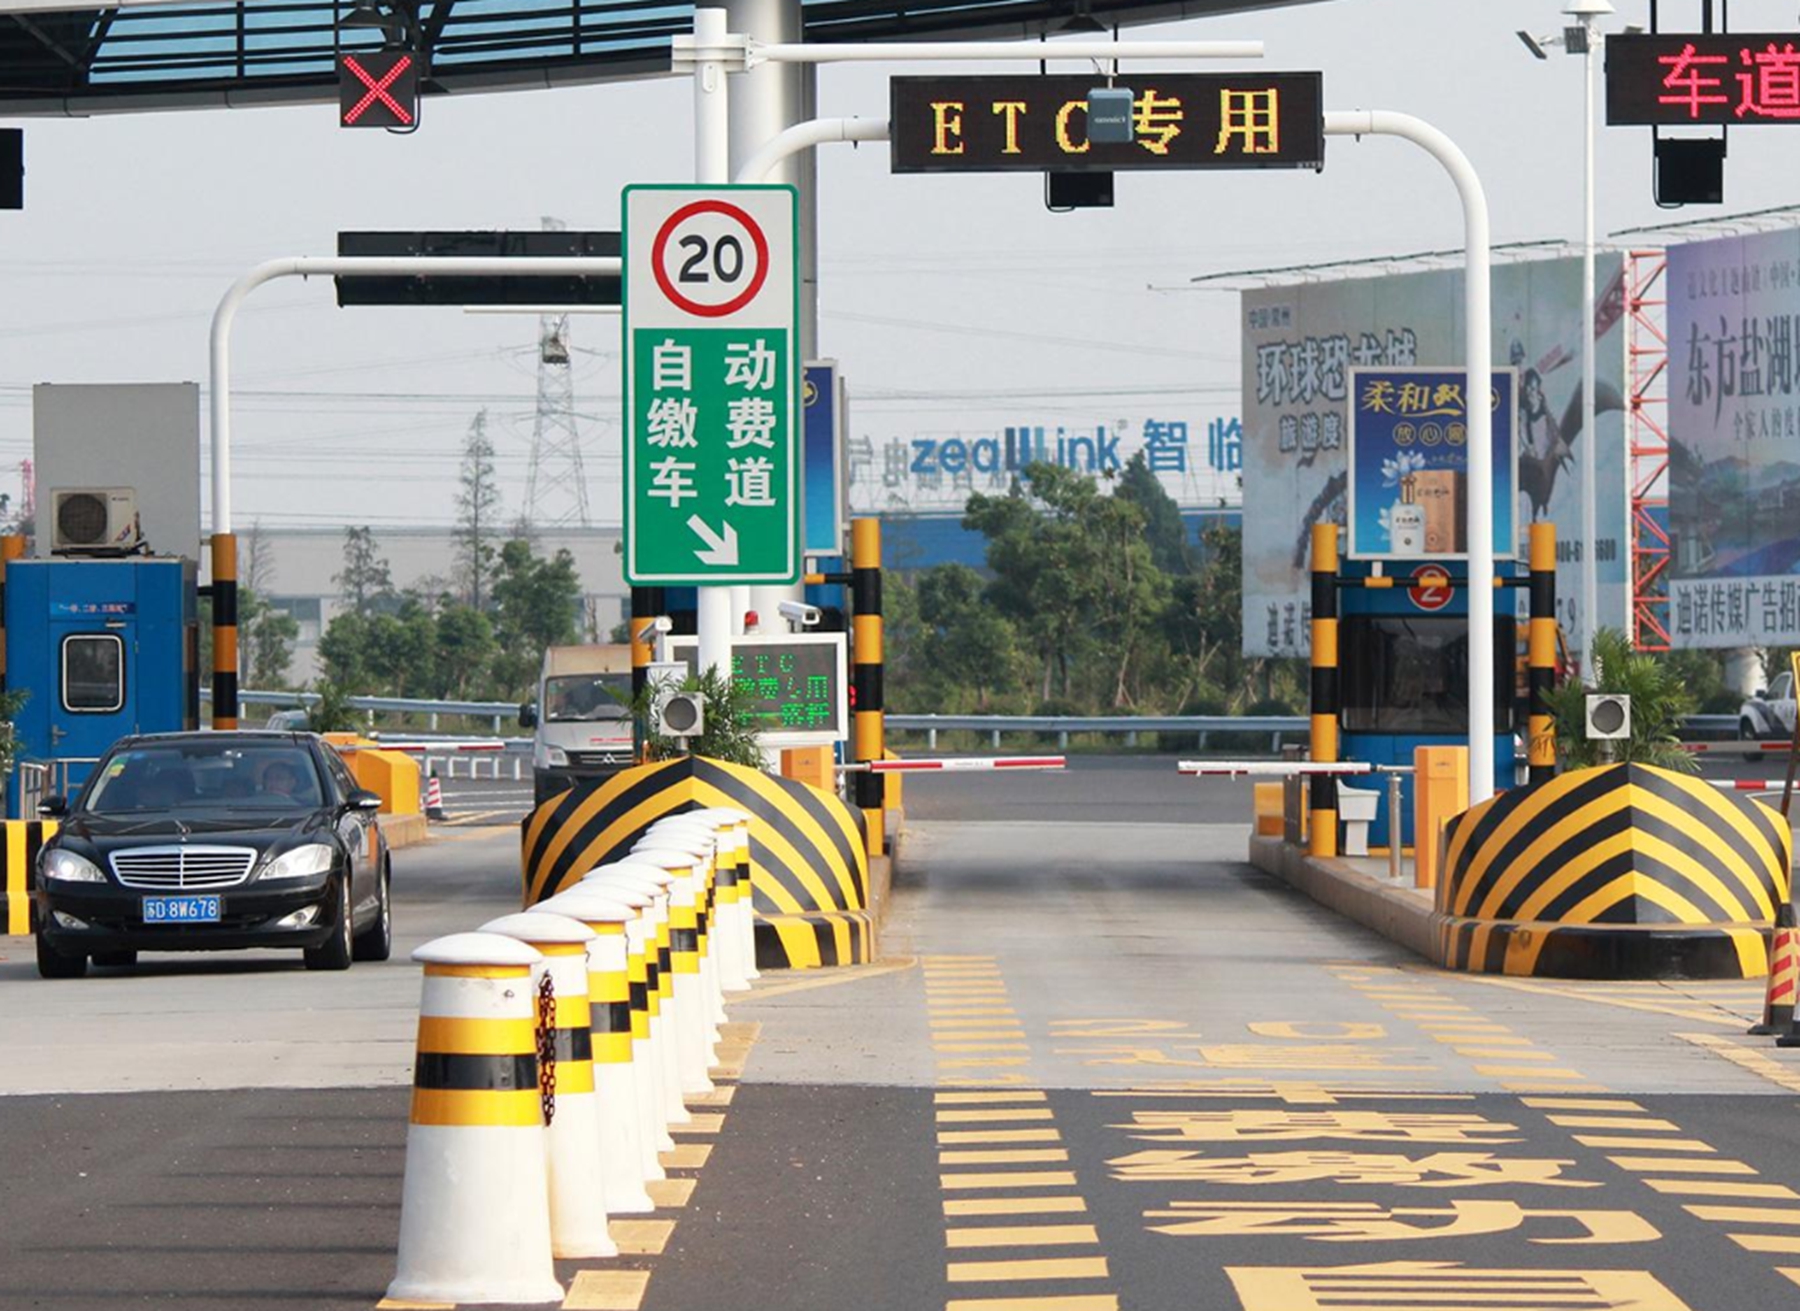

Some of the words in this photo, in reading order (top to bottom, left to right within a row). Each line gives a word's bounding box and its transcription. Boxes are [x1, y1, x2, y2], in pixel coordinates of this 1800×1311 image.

[1657, 43, 1800, 119] 车道
[678, 234, 743, 283] 20
[652, 338, 777, 391] 自动
[1686, 314, 1800, 430] 东方盐湖
[647, 397, 777, 449] 缴费
[1733, 407, 1800, 441] 全家人的度
[647, 457, 777, 508] 车道
[1676, 580, 1800, 635] 迪诺传媒广告招
